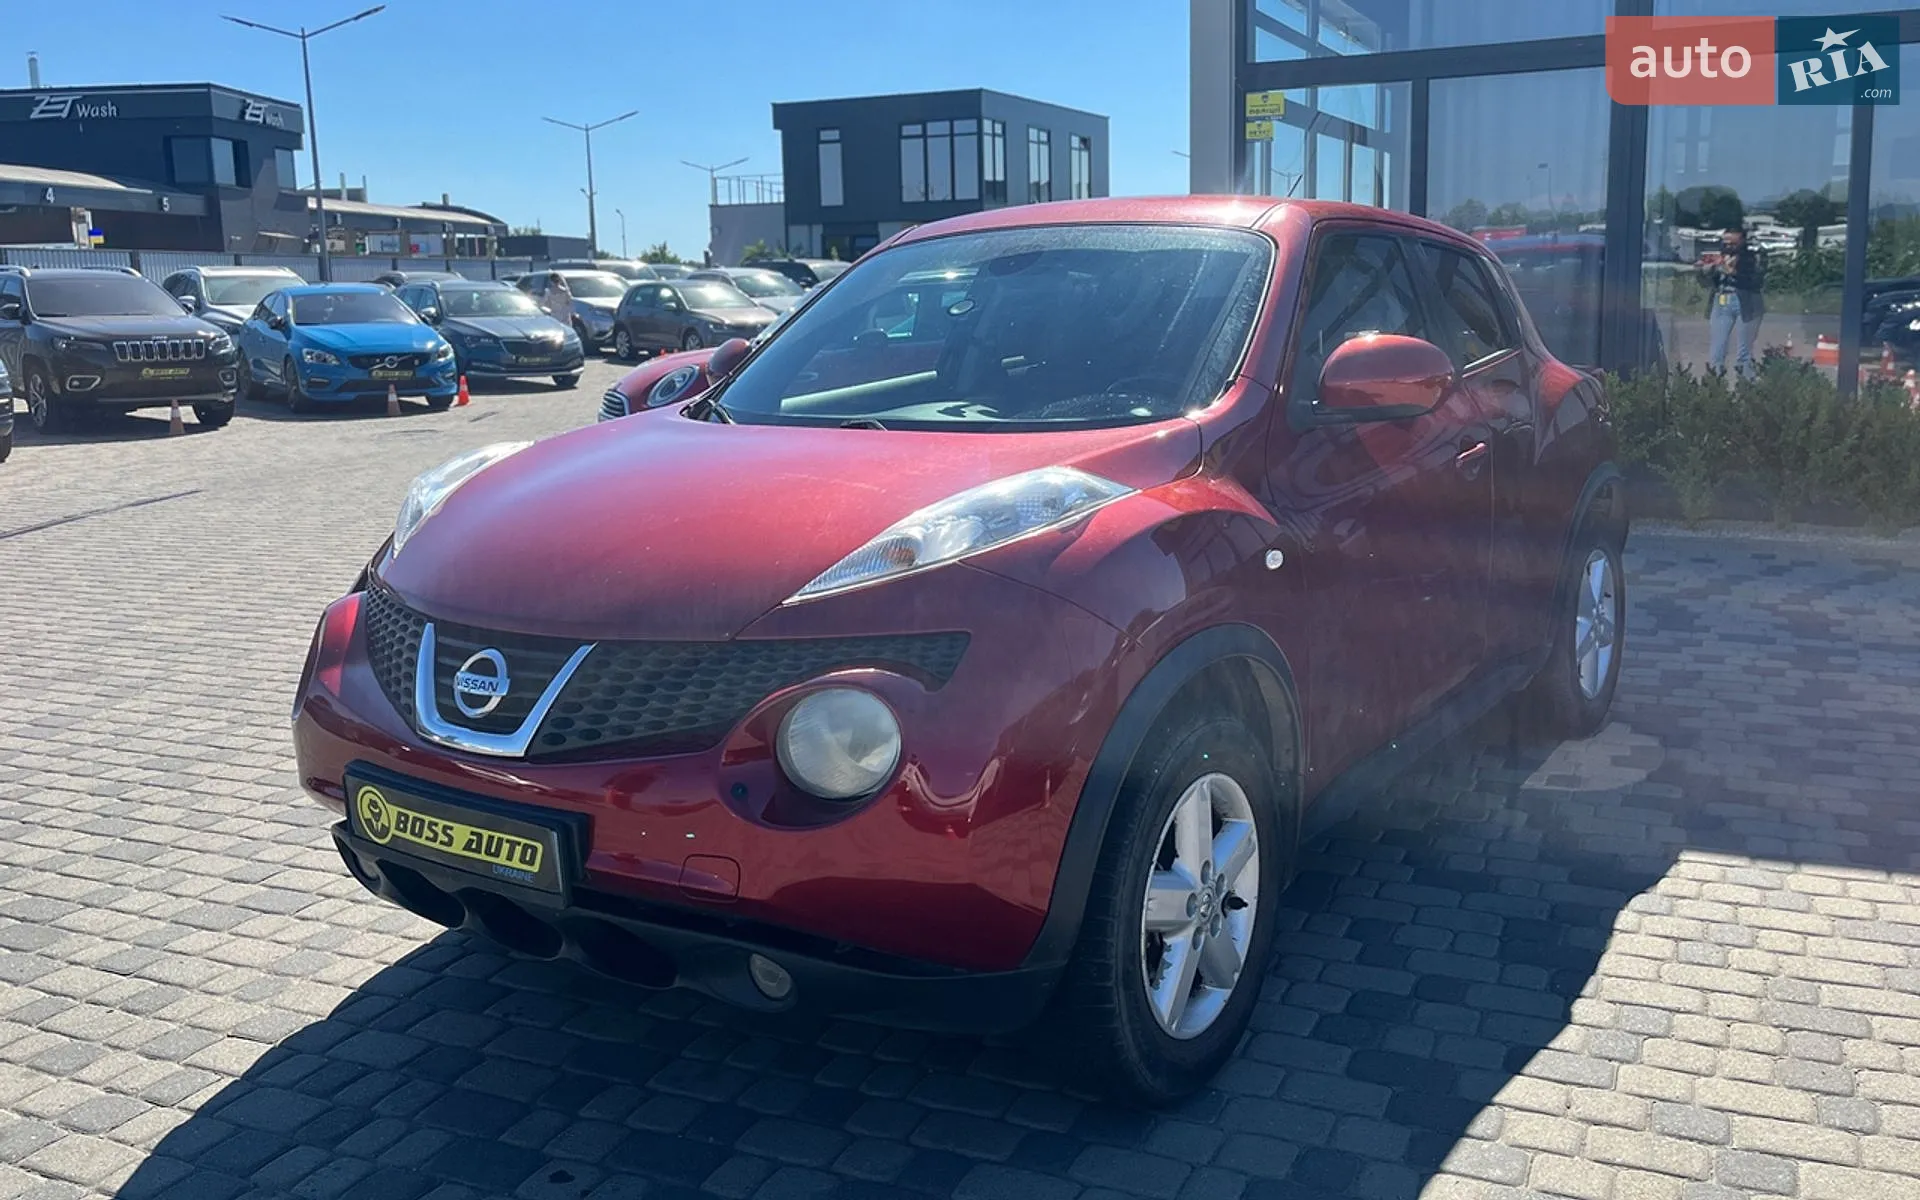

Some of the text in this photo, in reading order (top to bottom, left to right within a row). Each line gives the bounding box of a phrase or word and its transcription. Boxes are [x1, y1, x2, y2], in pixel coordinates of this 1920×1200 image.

[76, 99, 117, 118] Wash
[46, 187, 55, 203] 4
[162, 196, 170, 212] 5
[456, 675, 500, 693] NISSAN
[394, 811, 538, 867] BOSS AUTO
[491, 864, 536, 883] UKRAINE
